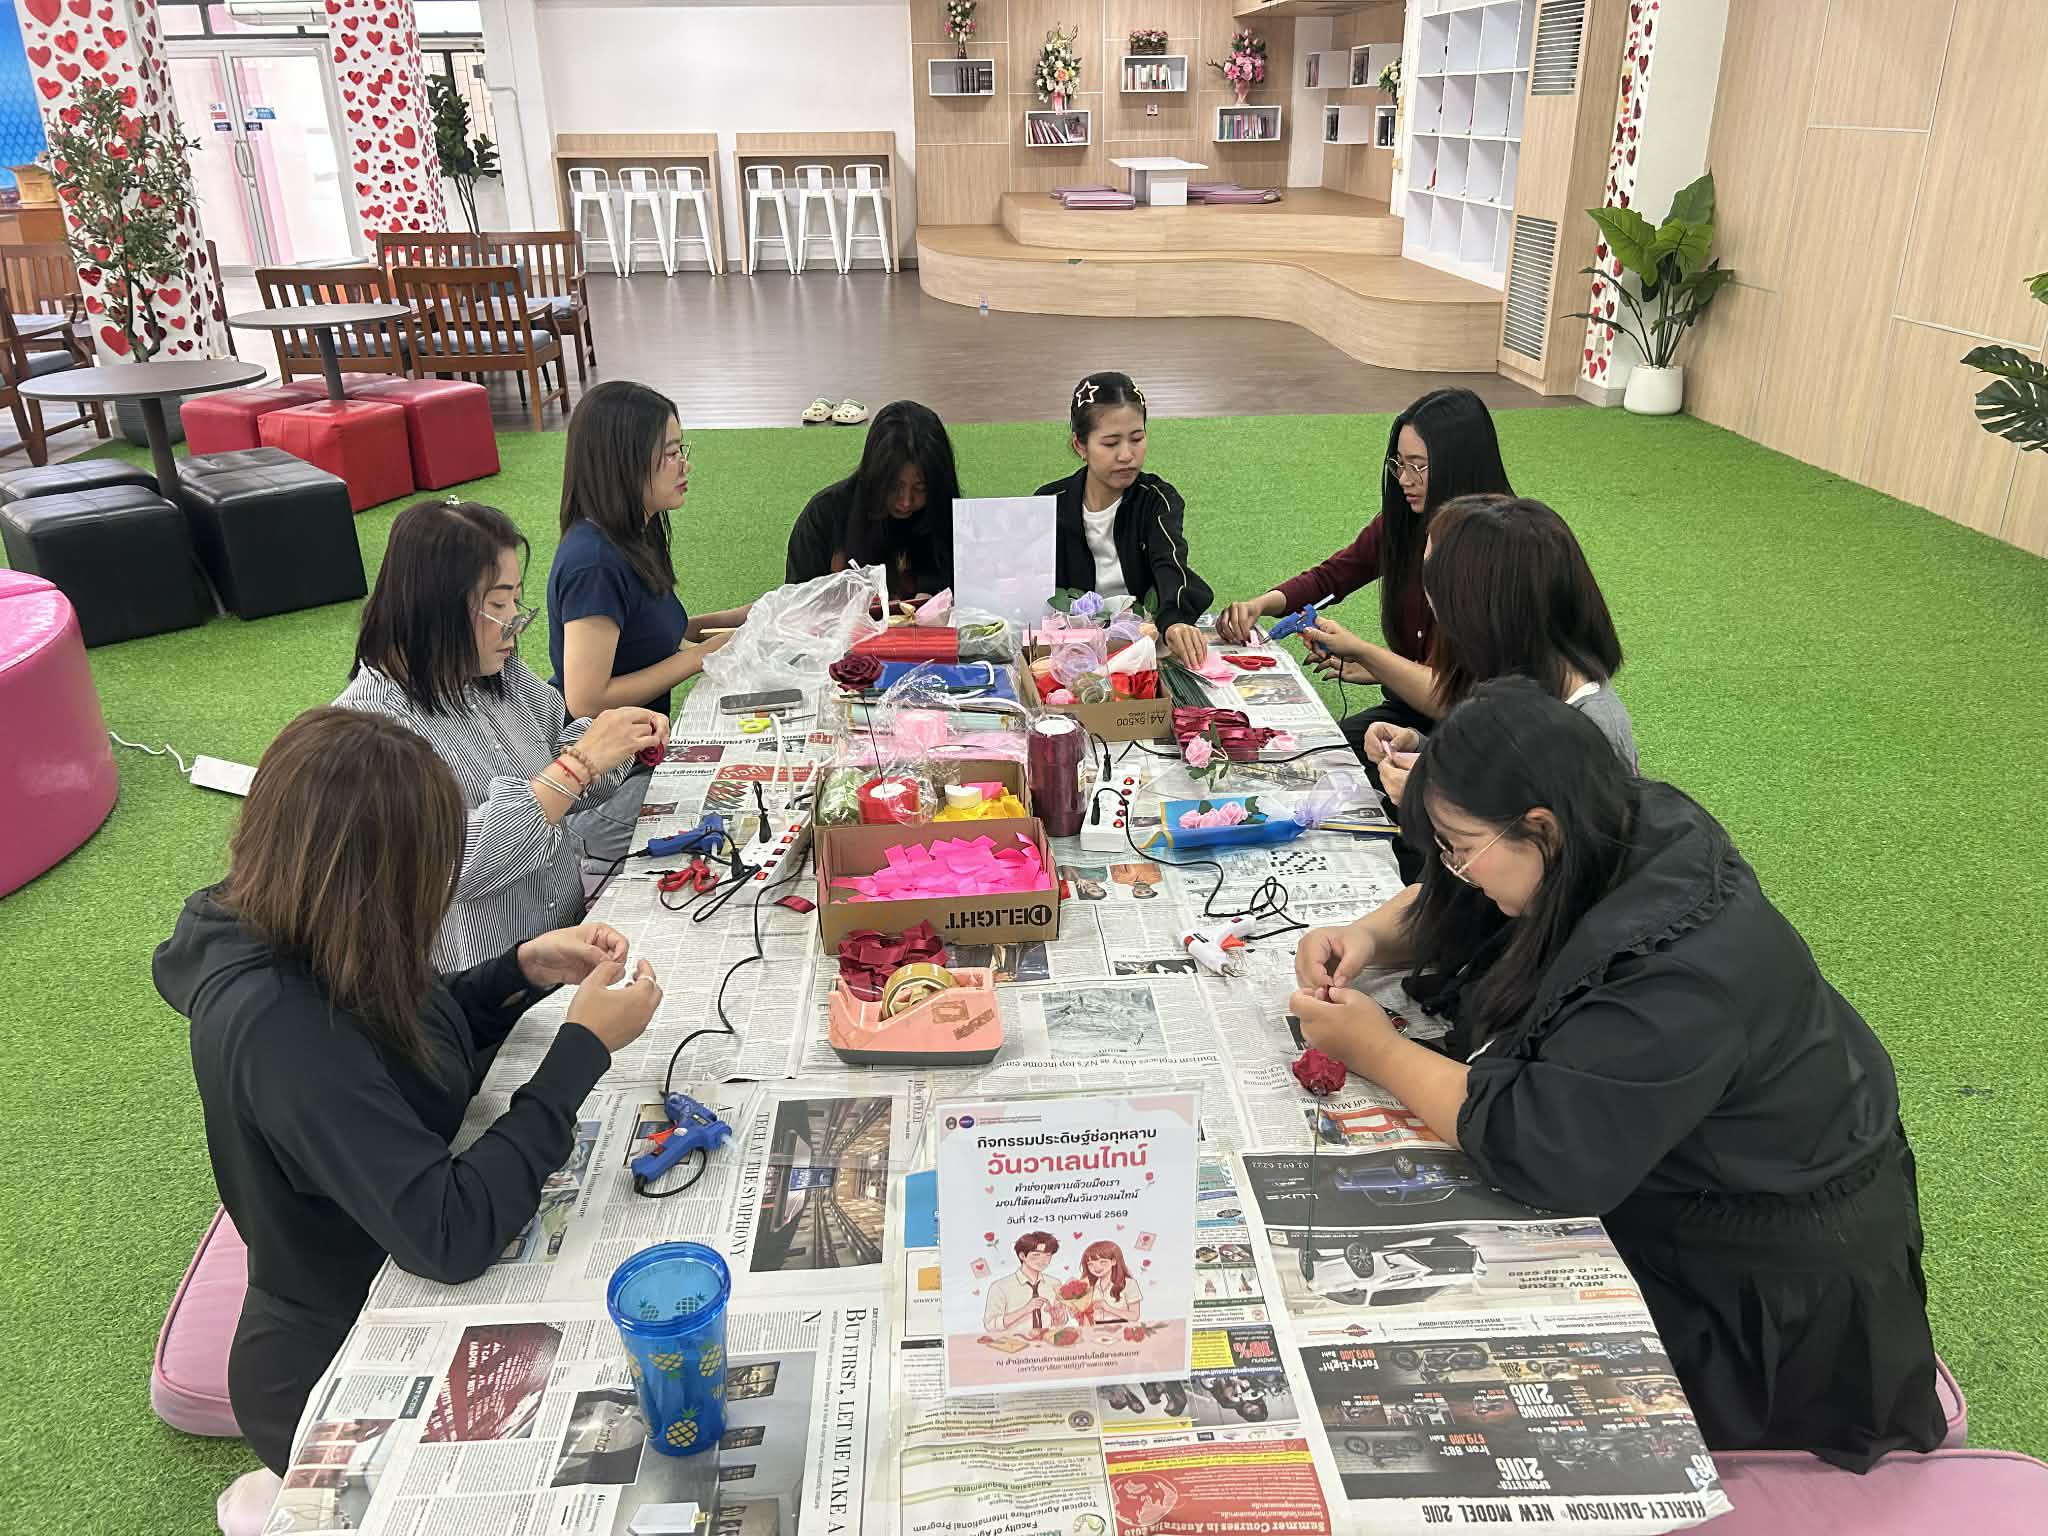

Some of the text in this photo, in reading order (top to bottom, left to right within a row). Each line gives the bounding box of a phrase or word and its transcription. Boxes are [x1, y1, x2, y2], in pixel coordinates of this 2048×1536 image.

[945, 905, 1053, 929] DELIGHT
[1022, 1061, 1057, 1069] income
[1059, 1059, 1075, 1068] top
[1077, 1059, 1098, 1068] NZ's
[1113, 1057, 1137, 1067] dairy
[1139, 1056, 1177, 1065] replaces
[1179, 1055, 1218, 1065] Tourism
[752, 1111, 770, 1142] TECH
[977, 1127, 1157, 1150] กิจกรรมประดิษฐ์ช่อกุหลาบ
[987, 1143, 1149, 1176] วันวาเลนไทน์
[743, 1159, 762, 1185] THE
[729, 1186, 759, 1258] SYMPHONY
[1006, 1213, 1026, 1225] วันที่
[1028, 1214, 1055, 1224] 12-13
[1104, 1209, 1128, 1219] 2569
[845, 1308, 868, 1342] BUT
[836, 1344, 858, 1395] FIRST,
[1509, 1383, 1554, 1404] 2016
[837, 1400, 855, 1430] LET
[1518, 1403, 1574, 1418] TOURING
[834, 1436, 852, 1461] ME
[1465, 1445, 1491, 1457] Iron
[1496, 1457, 1545, 1481] 2016
[830, 1465, 850, 1516] TAKE
[953, 1481, 1052, 1493] Admission Requirements
[913, 1501, 1097, 1533] Tropical Agriculture International Program
[1422, 1504, 1453, 1523] 2016
[1458, 1503, 1512, 1522] MODEL
[1518, 1502, 1555, 1521] NEW
[993, 1527, 1003, 1536] of
[1005, 1521, 1038, 1534] Faculty
[1150, 1520, 1205, 1533] Australia
[1206, 1522, 1219, 1533] in
[1221, 1522, 1271, 1533] Courses
[1273, 1520, 1325, 1533] Summer
